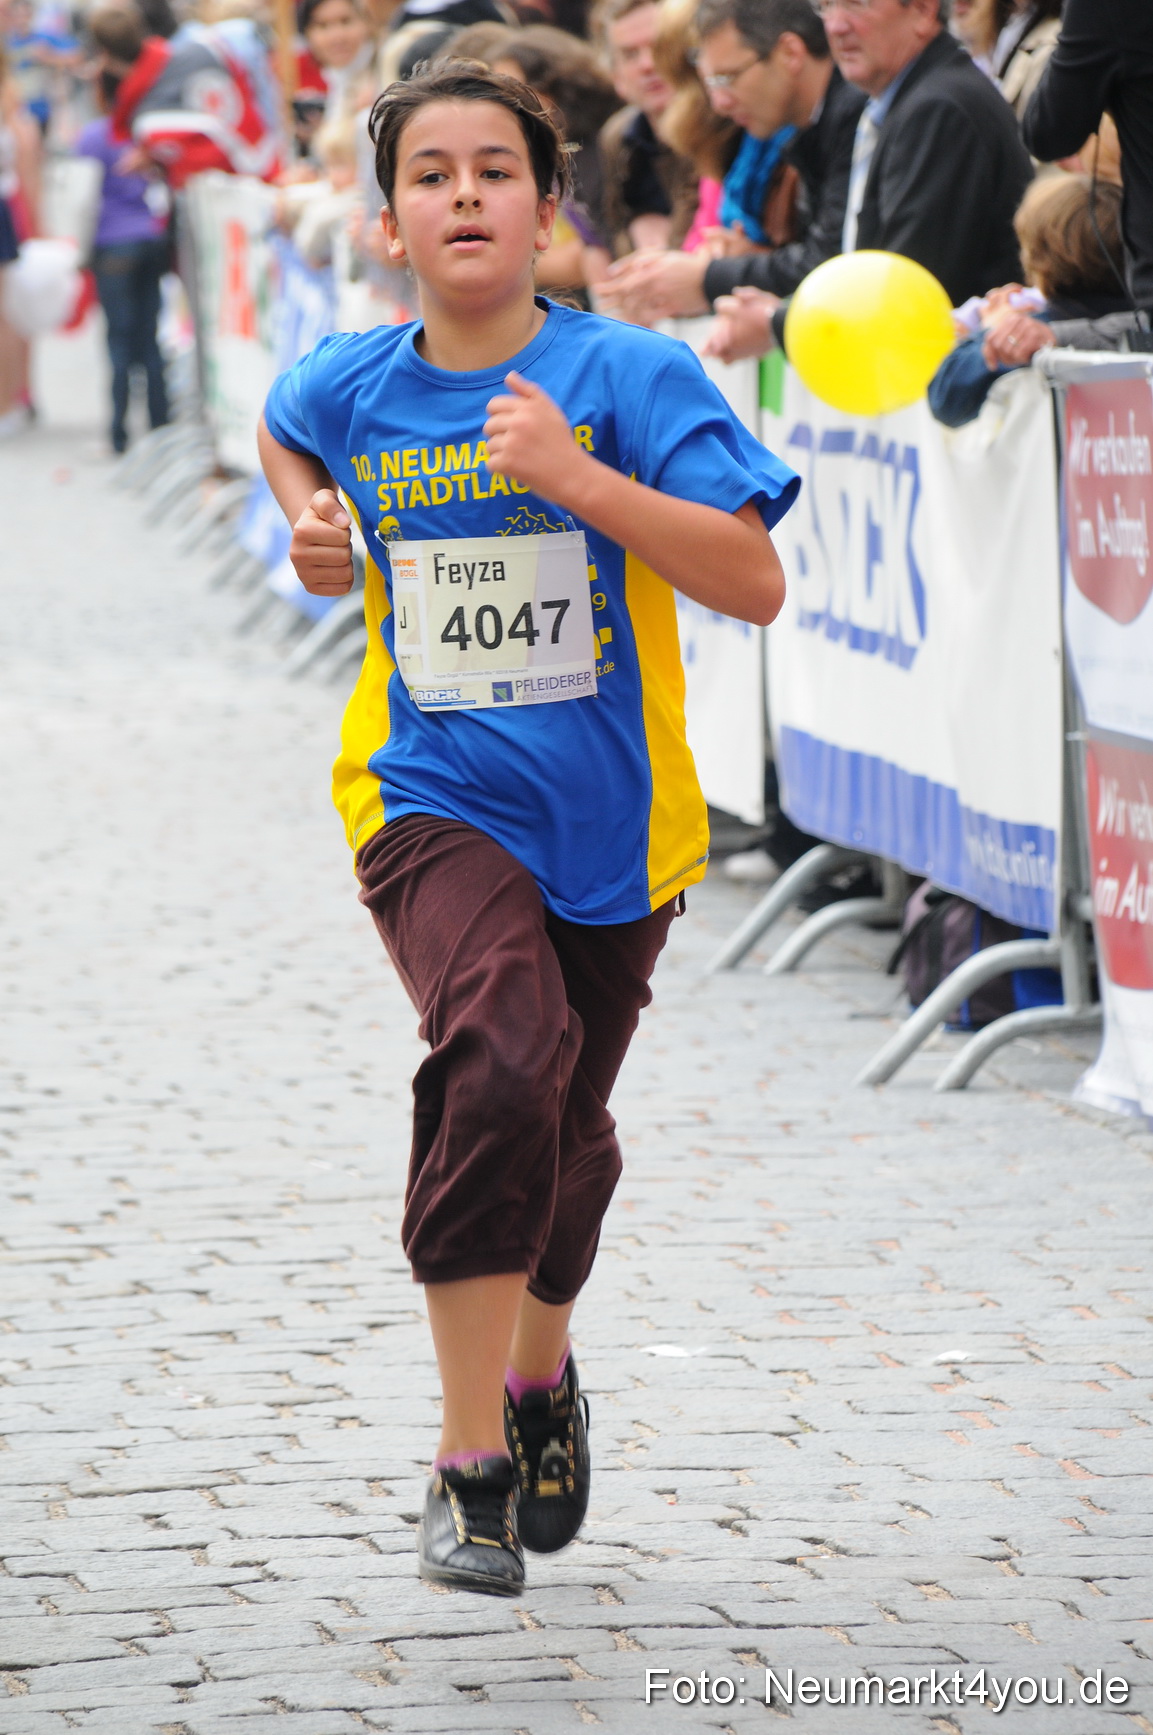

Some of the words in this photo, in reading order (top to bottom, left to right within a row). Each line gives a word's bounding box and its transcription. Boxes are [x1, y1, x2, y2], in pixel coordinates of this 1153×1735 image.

[351, 454, 377, 482] 10.
[380, 425, 595, 480] NEUMAR
[433, 553, 506, 590] Feyza
[399, 605, 407, 629] J
[440, 598, 571, 651] 4047
[415, 688, 462, 702] BOCK
[515, 671, 592, 693] PFLEIDERER
